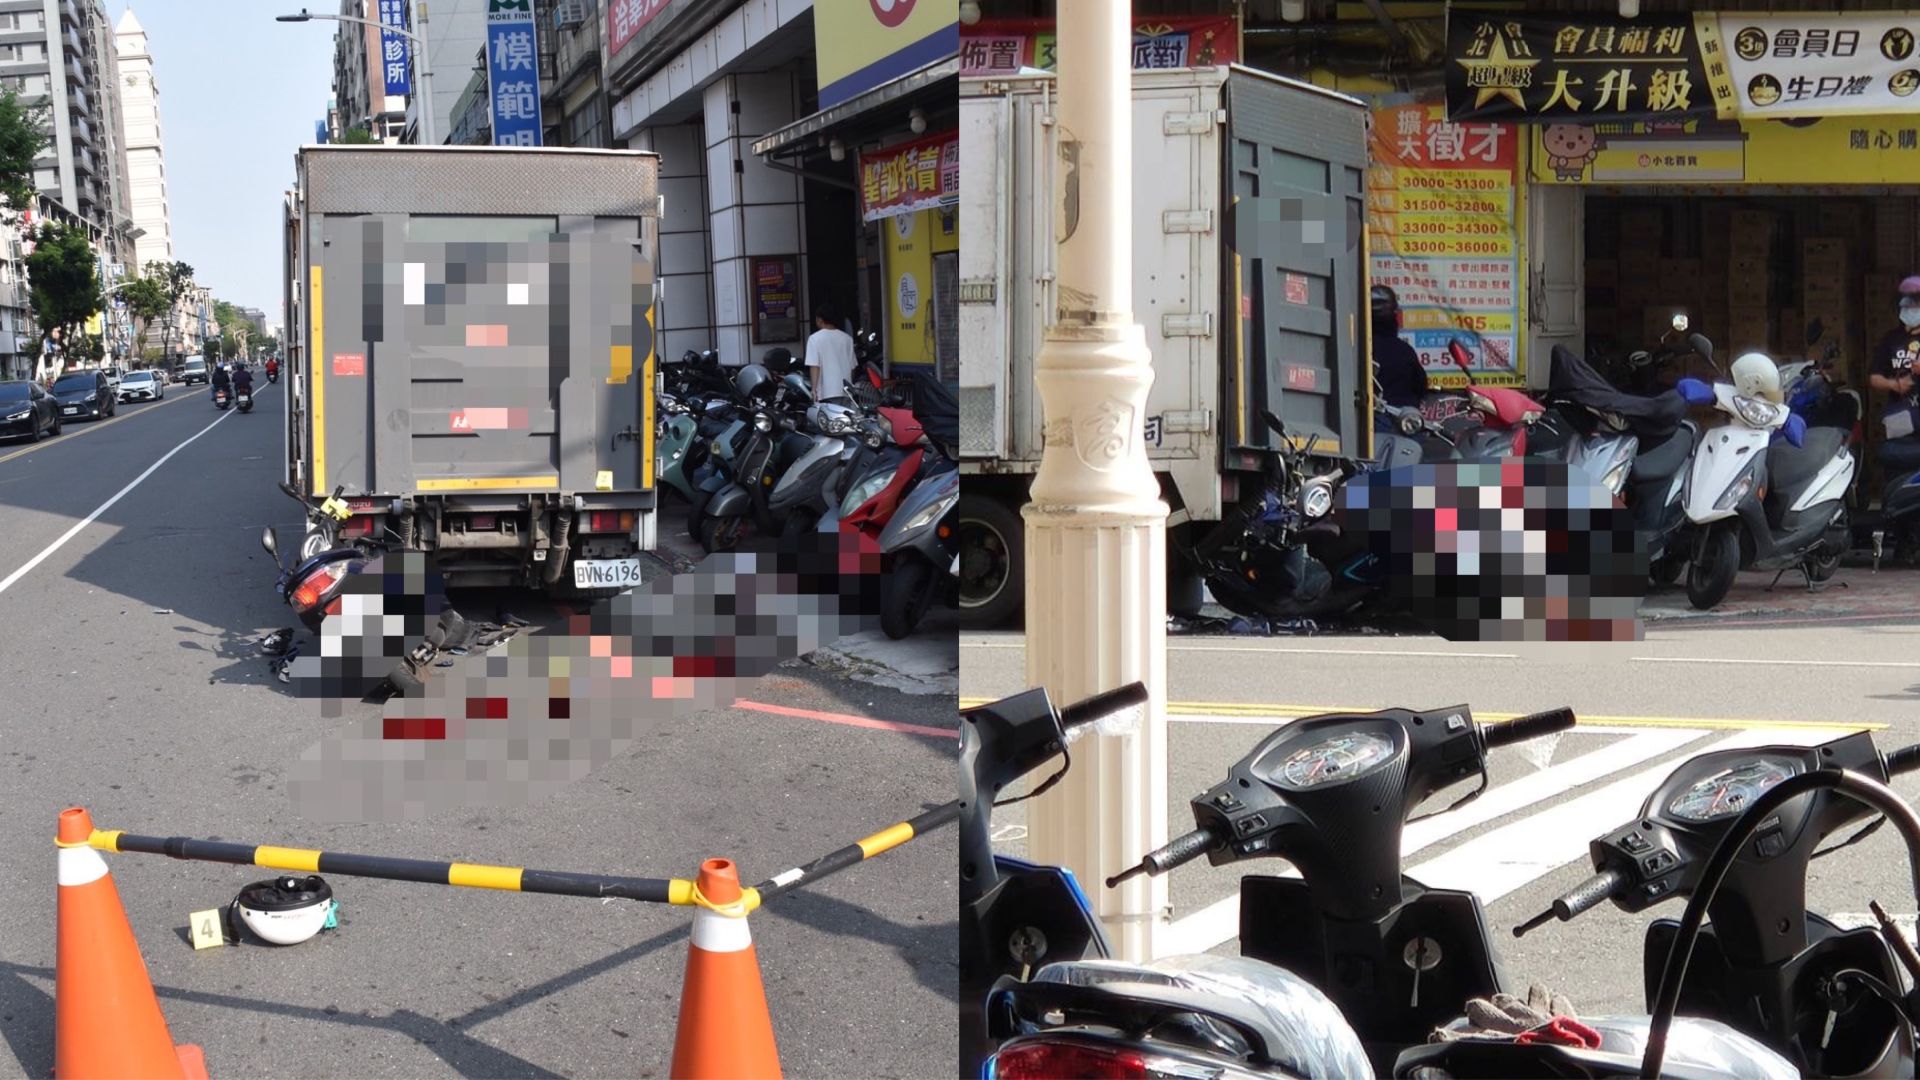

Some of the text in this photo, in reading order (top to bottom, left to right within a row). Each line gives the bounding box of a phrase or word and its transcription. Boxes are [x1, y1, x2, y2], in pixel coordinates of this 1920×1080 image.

[514, 12, 532, 20] FINE
[1552, 25, 1686, 54] 會員福利
[1772, 28, 1860, 58] 會員日
[385, 40, 405, 83] 診所
[1704, 40, 1731, 99] 新推出
[1539, 68, 1692, 112] 大升級
[1784, 75, 1873, 102] 生日禮
[1397, 110, 1422, 161] 擴大
[1426, 122, 1506, 162] 徵才
[1850, 128, 1918, 150] 隨心購
[863, 146, 940, 204] 聖誕特賣
[201, 918, 214, 938] 4
